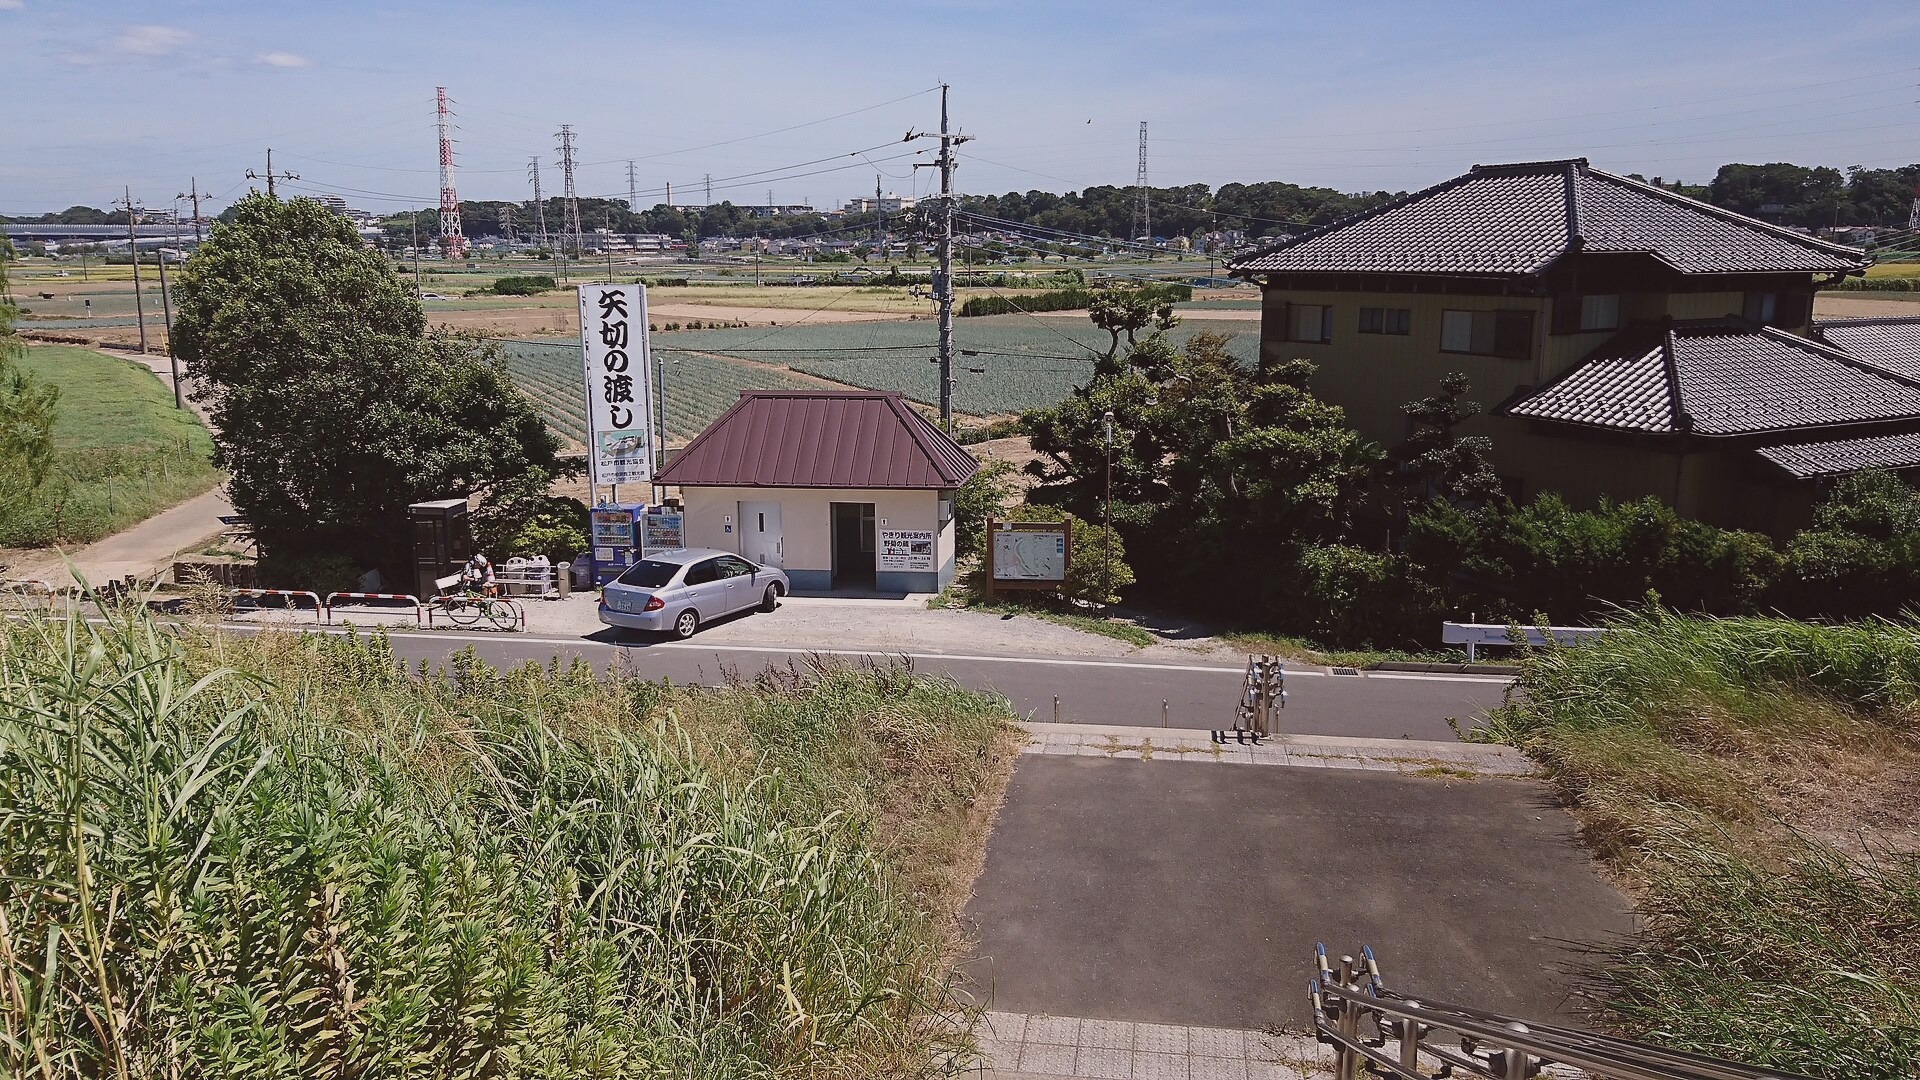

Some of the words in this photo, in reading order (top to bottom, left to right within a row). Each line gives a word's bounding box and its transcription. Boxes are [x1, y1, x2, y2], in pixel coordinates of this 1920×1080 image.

[598, 289, 634, 429] 矢切の渡し
[600, 458, 644, 466] 松戸市観光協会
